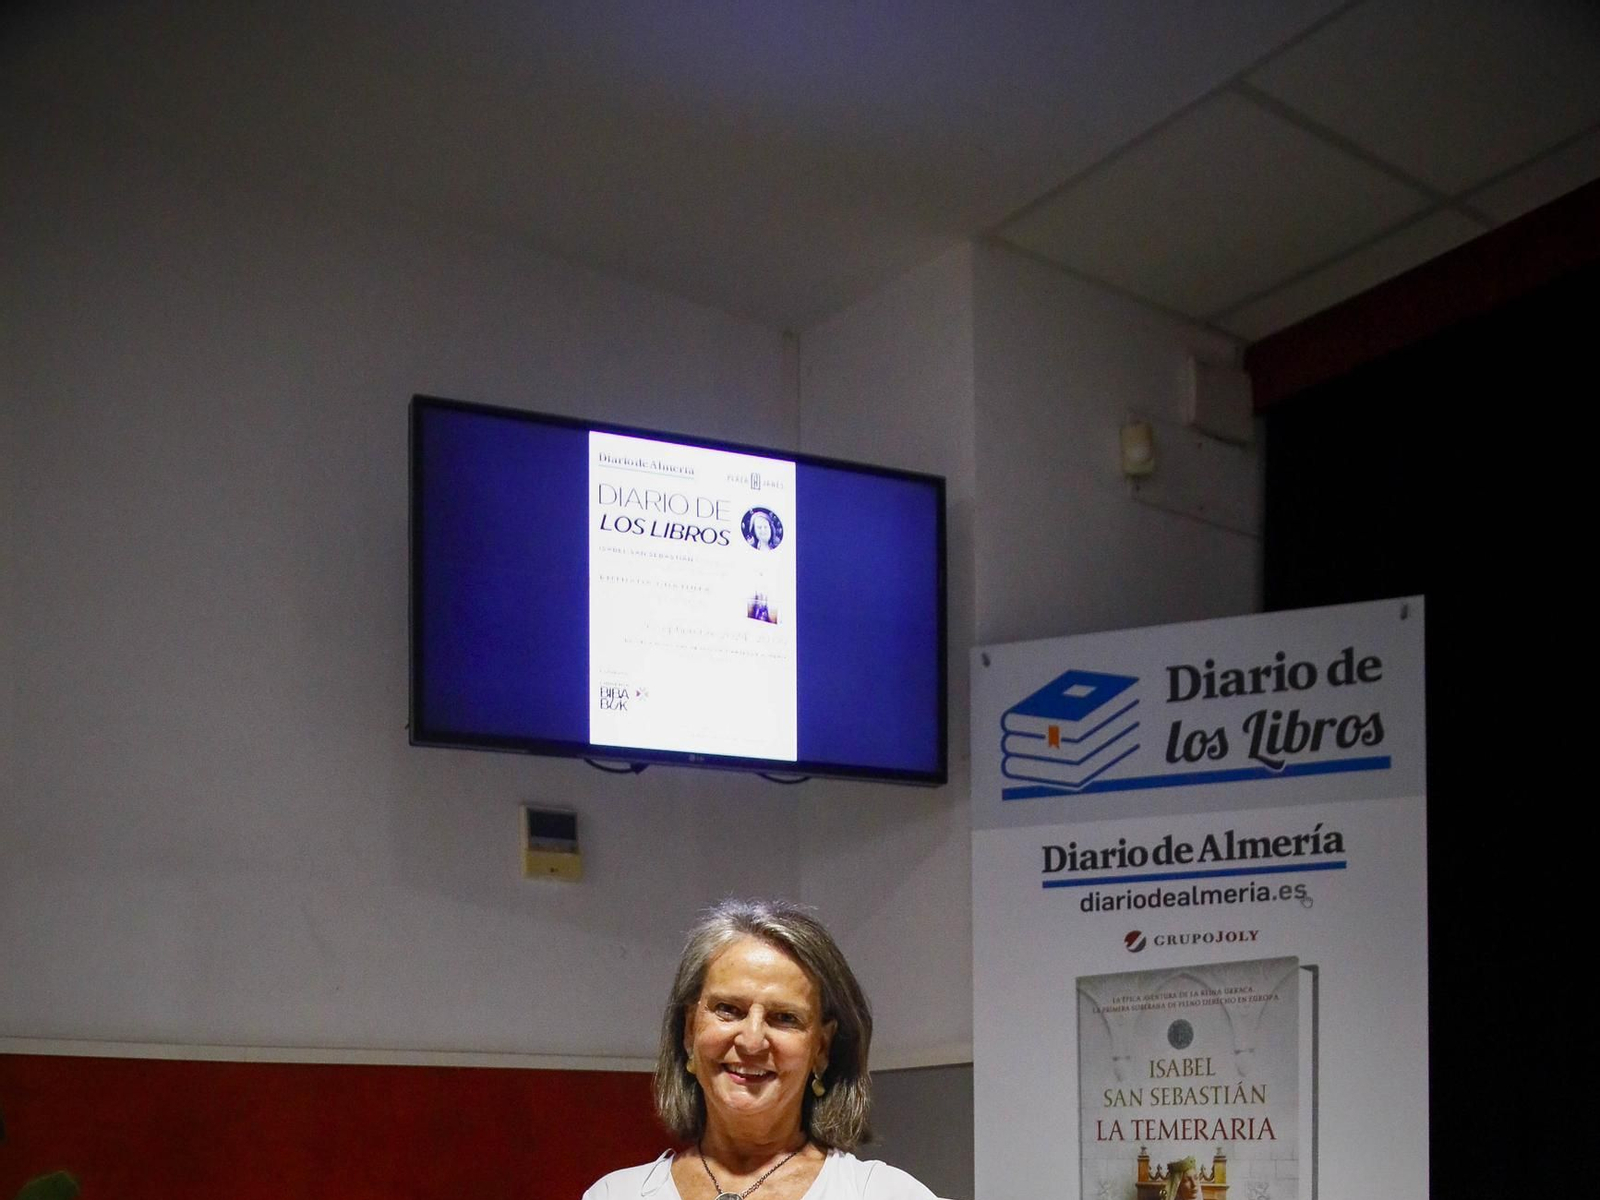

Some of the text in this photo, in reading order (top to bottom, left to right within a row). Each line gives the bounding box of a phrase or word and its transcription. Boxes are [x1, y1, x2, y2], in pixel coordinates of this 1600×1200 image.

[599, 452, 635, 466] Diario
[635, 455, 648, 468] de
[599, 483, 731, 521] DIARIO DE
[600, 514, 732, 547] LOS LIBROS
[1166, 646, 1382, 703] Diario de
[1165, 708, 1385, 771] los Libros
[1042, 823, 1346, 873] Diario de Almería
[1080, 881, 1308, 913] diariodealmeria.es
[1179, 990, 1188, 998] DE
[1189, 990, 1199, 998] LA
[1149, 1057, 1216, 1079] ISABEL
[1103, 1081, 1267, 1108] SAN SEBASTIÁN
[1097, 1117, 1277, 1141] LA TEMERARIA
